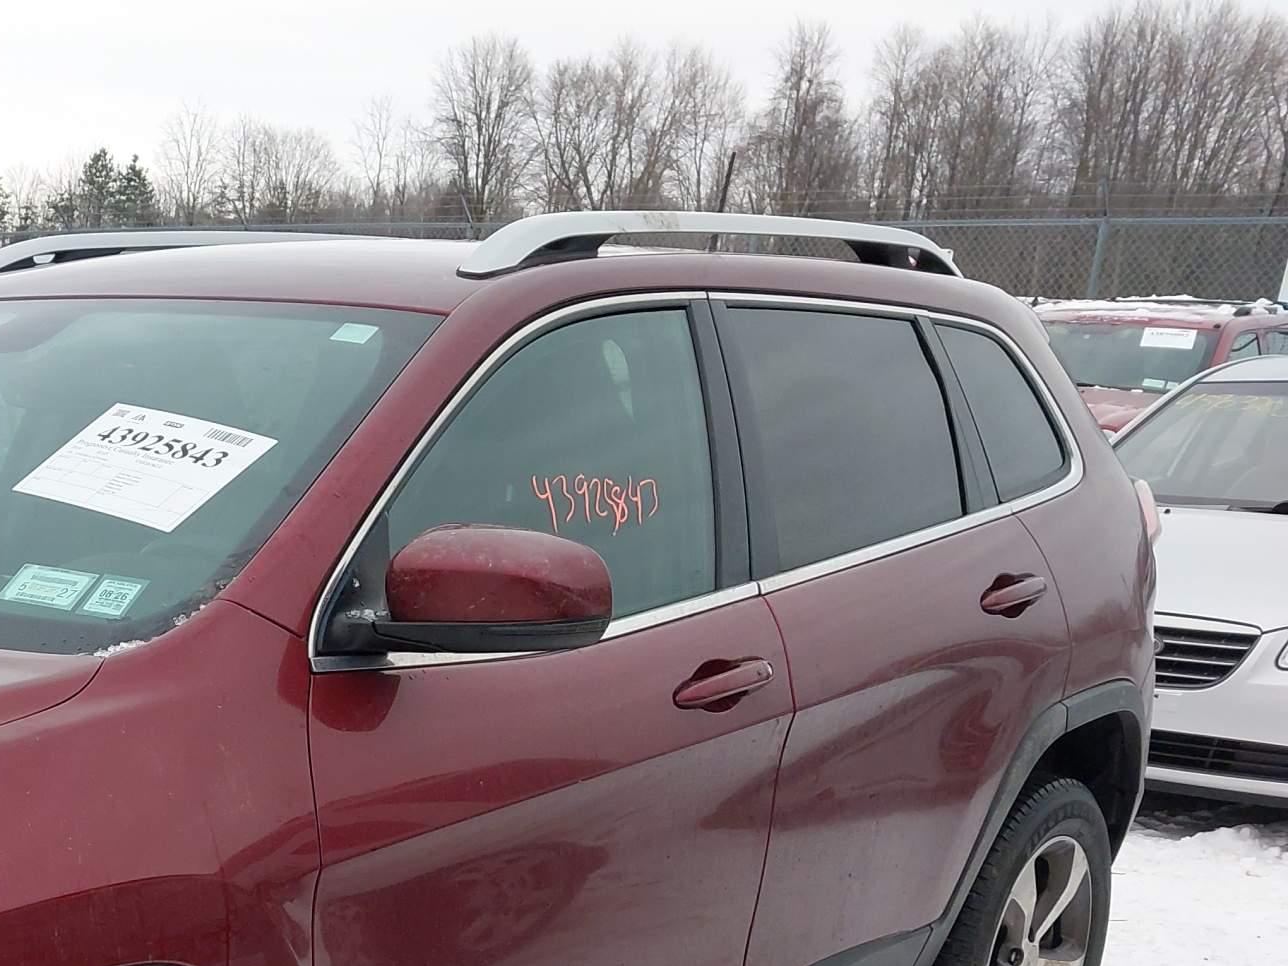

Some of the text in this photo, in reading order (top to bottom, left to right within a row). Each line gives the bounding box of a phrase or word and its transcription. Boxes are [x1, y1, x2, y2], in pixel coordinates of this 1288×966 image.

[96, 425, 229, 468] 43925843
[17, 581, 31, 592] 5
[56, 587, 79, 600] 27
